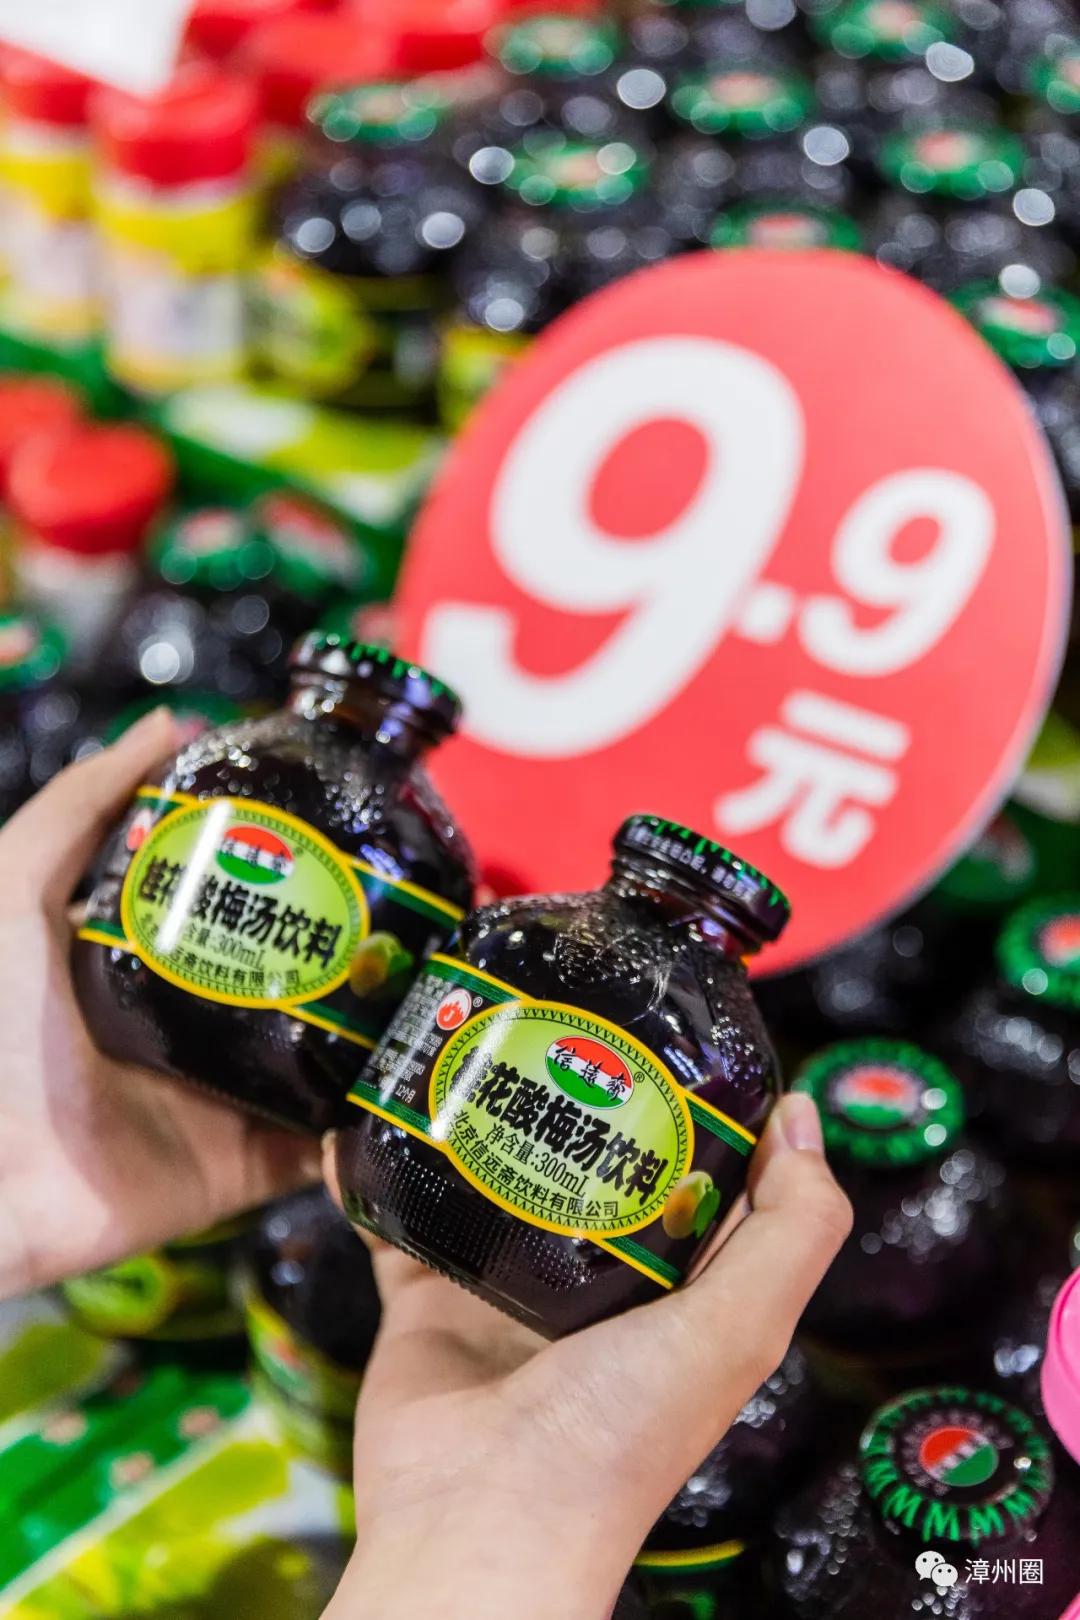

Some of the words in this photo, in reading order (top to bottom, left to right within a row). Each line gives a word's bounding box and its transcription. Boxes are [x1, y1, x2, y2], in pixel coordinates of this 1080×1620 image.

[714, 688, 910, 870] 元
[178, 921, 266, 972] 含量:300mL
[452, 1109, 619, 1219] 北京信远斋饮料有限公司
[485, 1122, 590, 1199] 净含量:300mL
